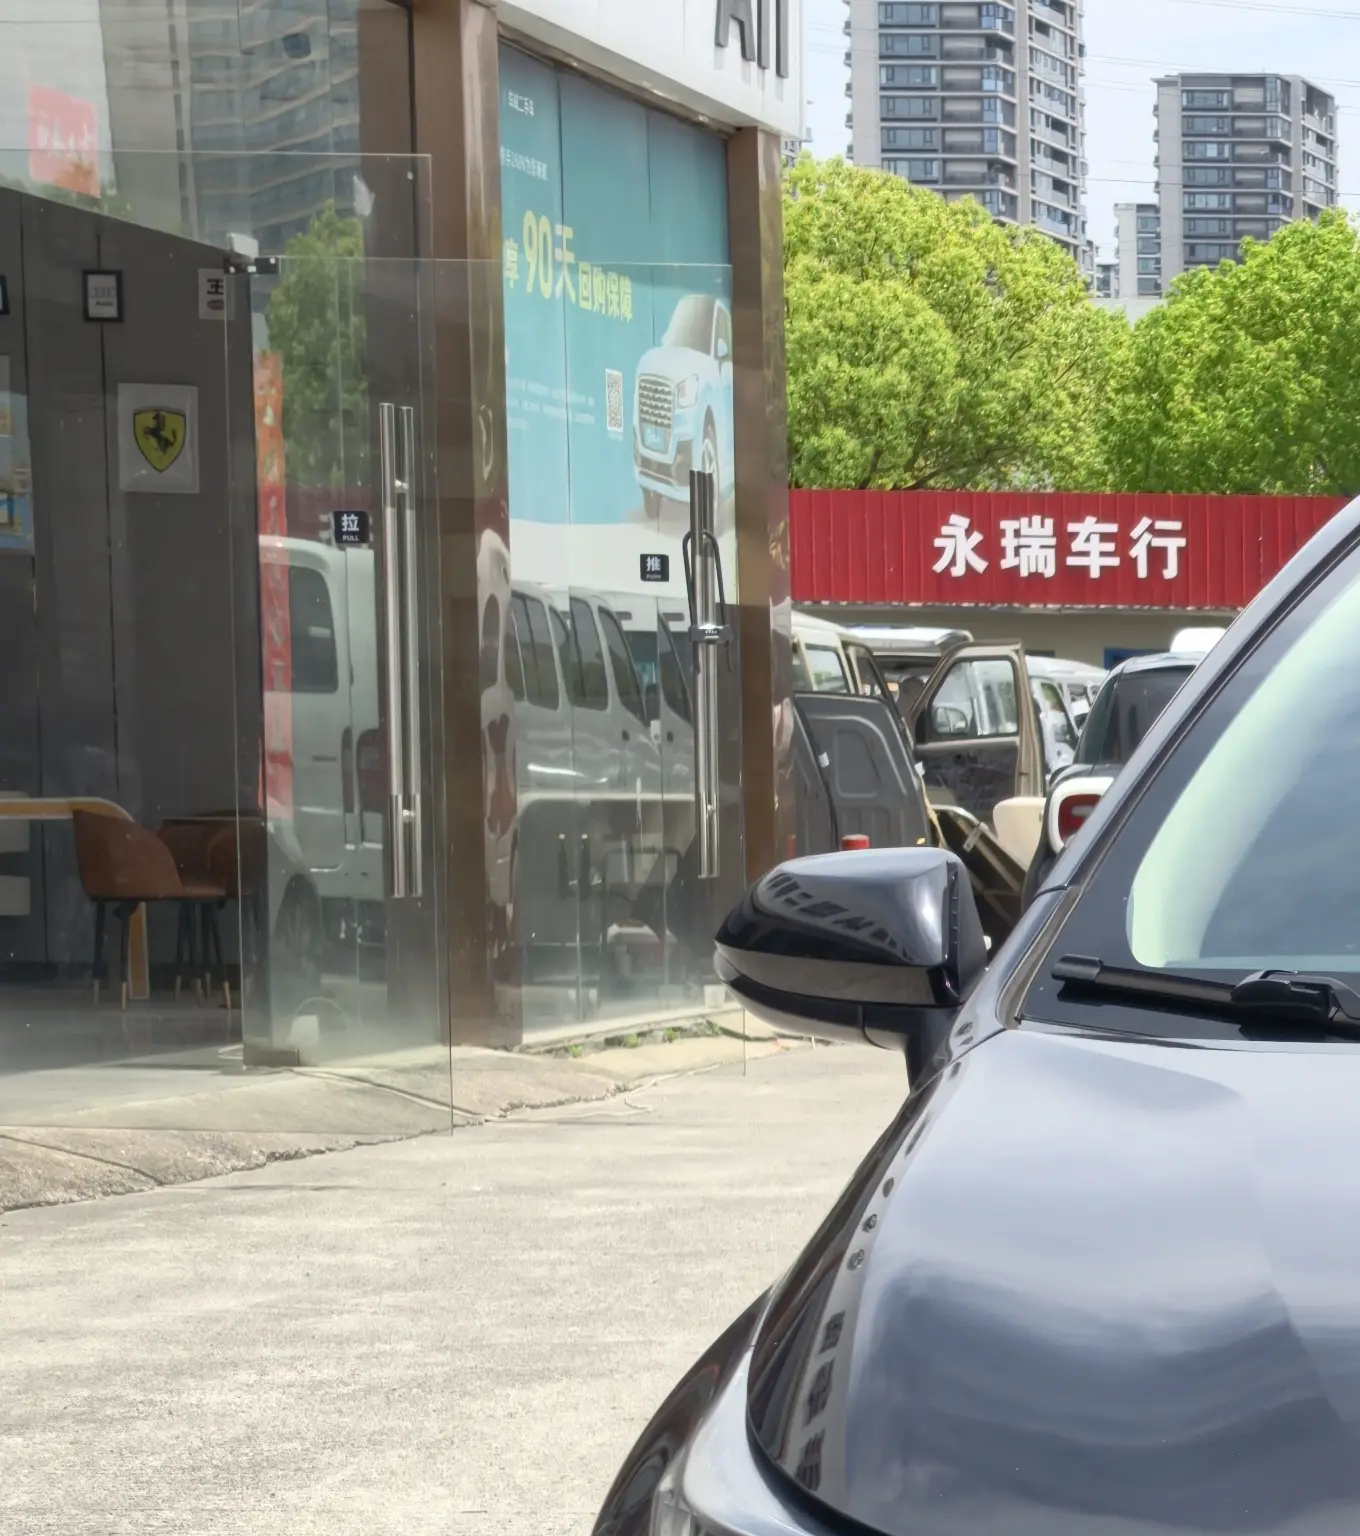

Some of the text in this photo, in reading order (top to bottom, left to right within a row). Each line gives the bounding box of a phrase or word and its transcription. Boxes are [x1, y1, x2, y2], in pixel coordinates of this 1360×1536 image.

[341, 513, 360, 532] 拉
[932, 513, 1187, 579] 永瑞车行
